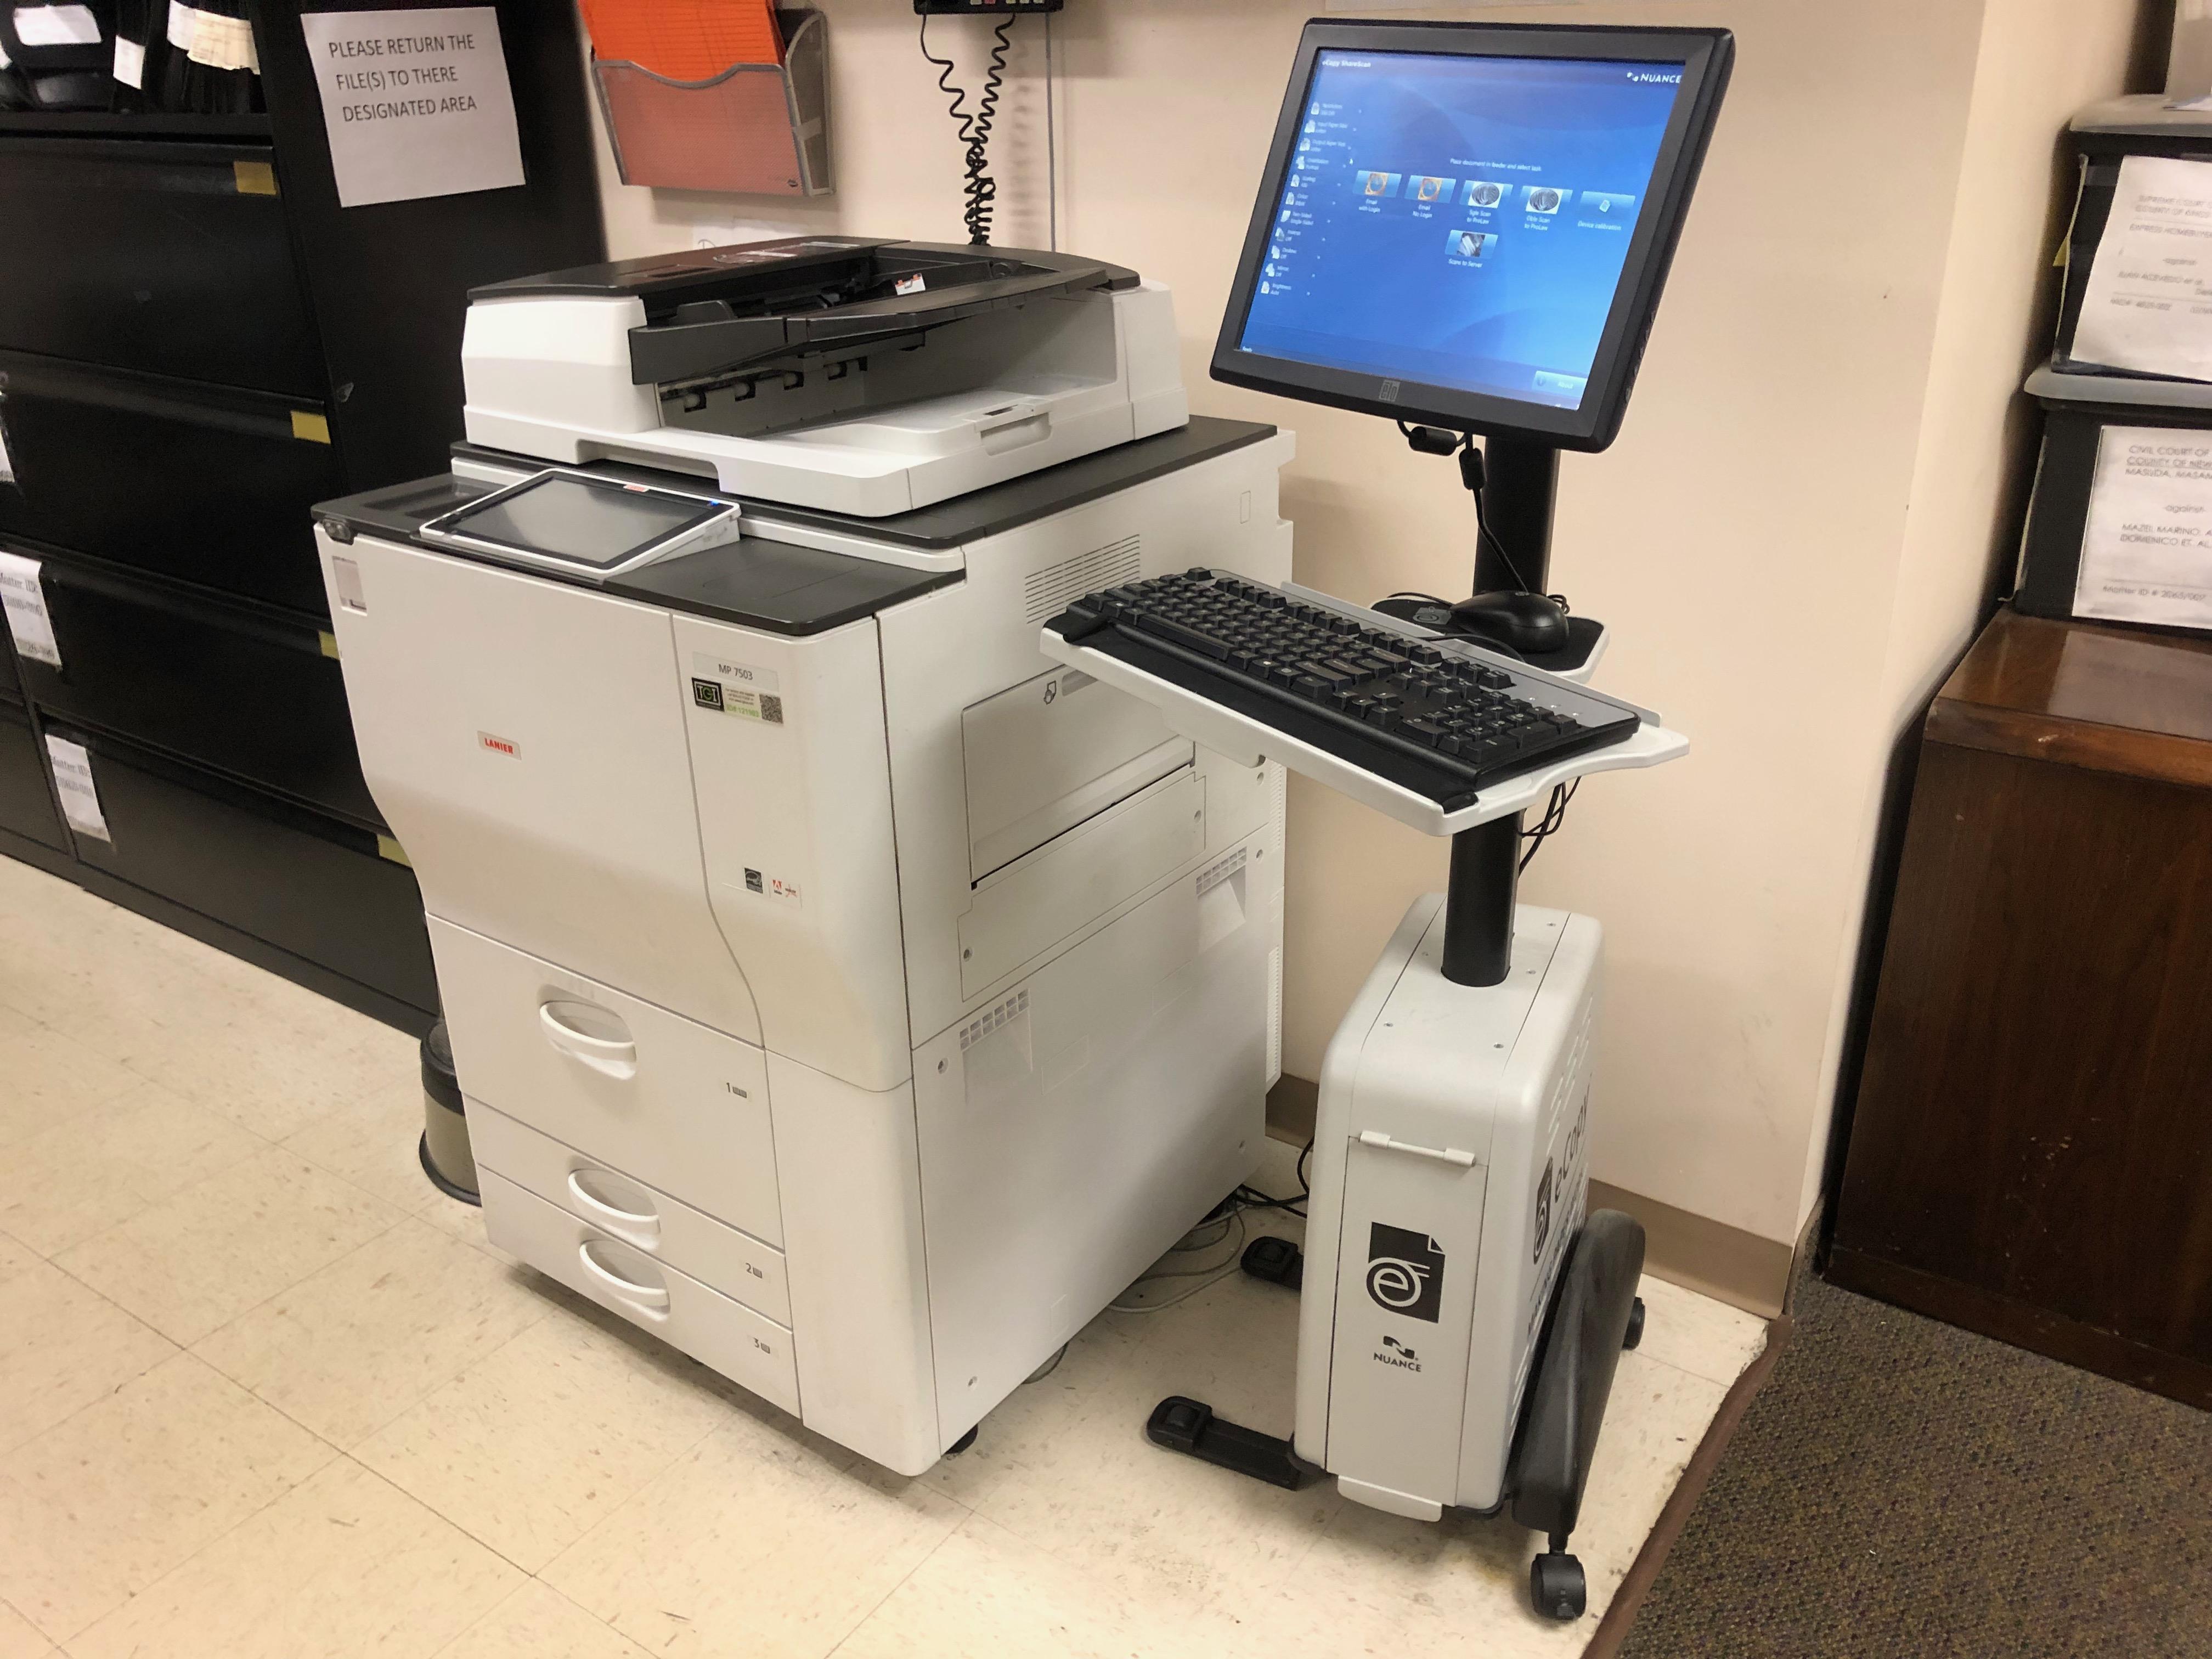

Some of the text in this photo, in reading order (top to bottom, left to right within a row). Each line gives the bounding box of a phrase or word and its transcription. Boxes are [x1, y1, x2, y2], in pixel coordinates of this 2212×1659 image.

[329, 34, 475, 58] PLEASE RETURN THE
[336, 66, 459, 91] FILE(S) TO THERE
[1640, 73, 1682, 83] NUANCE
[342, 95, 477, 122] DESIGNATED AREA
[1577, 220, 1622, 230] Device calibration
[2157, 447, 2193, 457] COURT
[718, 663, 753, 680] MP 7503
[484, 737, 514, 754] LANIER
[726, 1082, 731, 1093] 1
[746, 1262, 752, 1274] 2
[753, 1337, 759, 1348] 3
[1373, 1352, 1422, 1372] NUANCE
